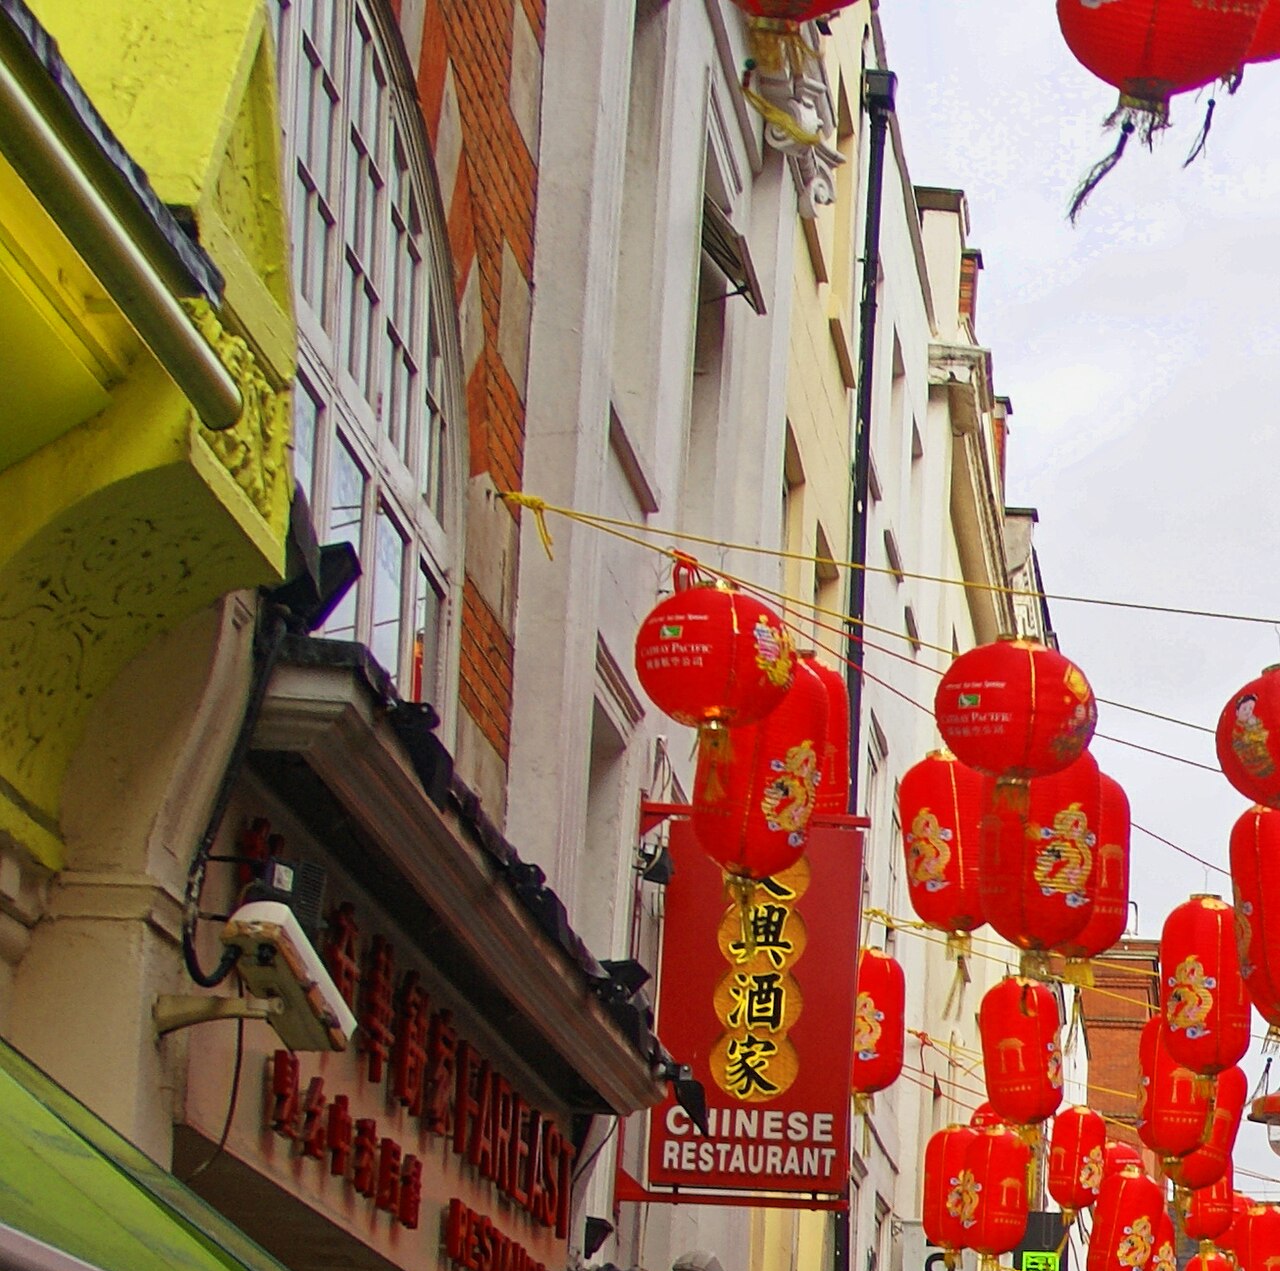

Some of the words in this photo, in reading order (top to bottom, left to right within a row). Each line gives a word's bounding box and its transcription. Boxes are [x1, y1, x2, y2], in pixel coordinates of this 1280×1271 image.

[728, 876, 797, 1099] 興酒家
[662, 1140, 836, 1177] RESTAURANT
